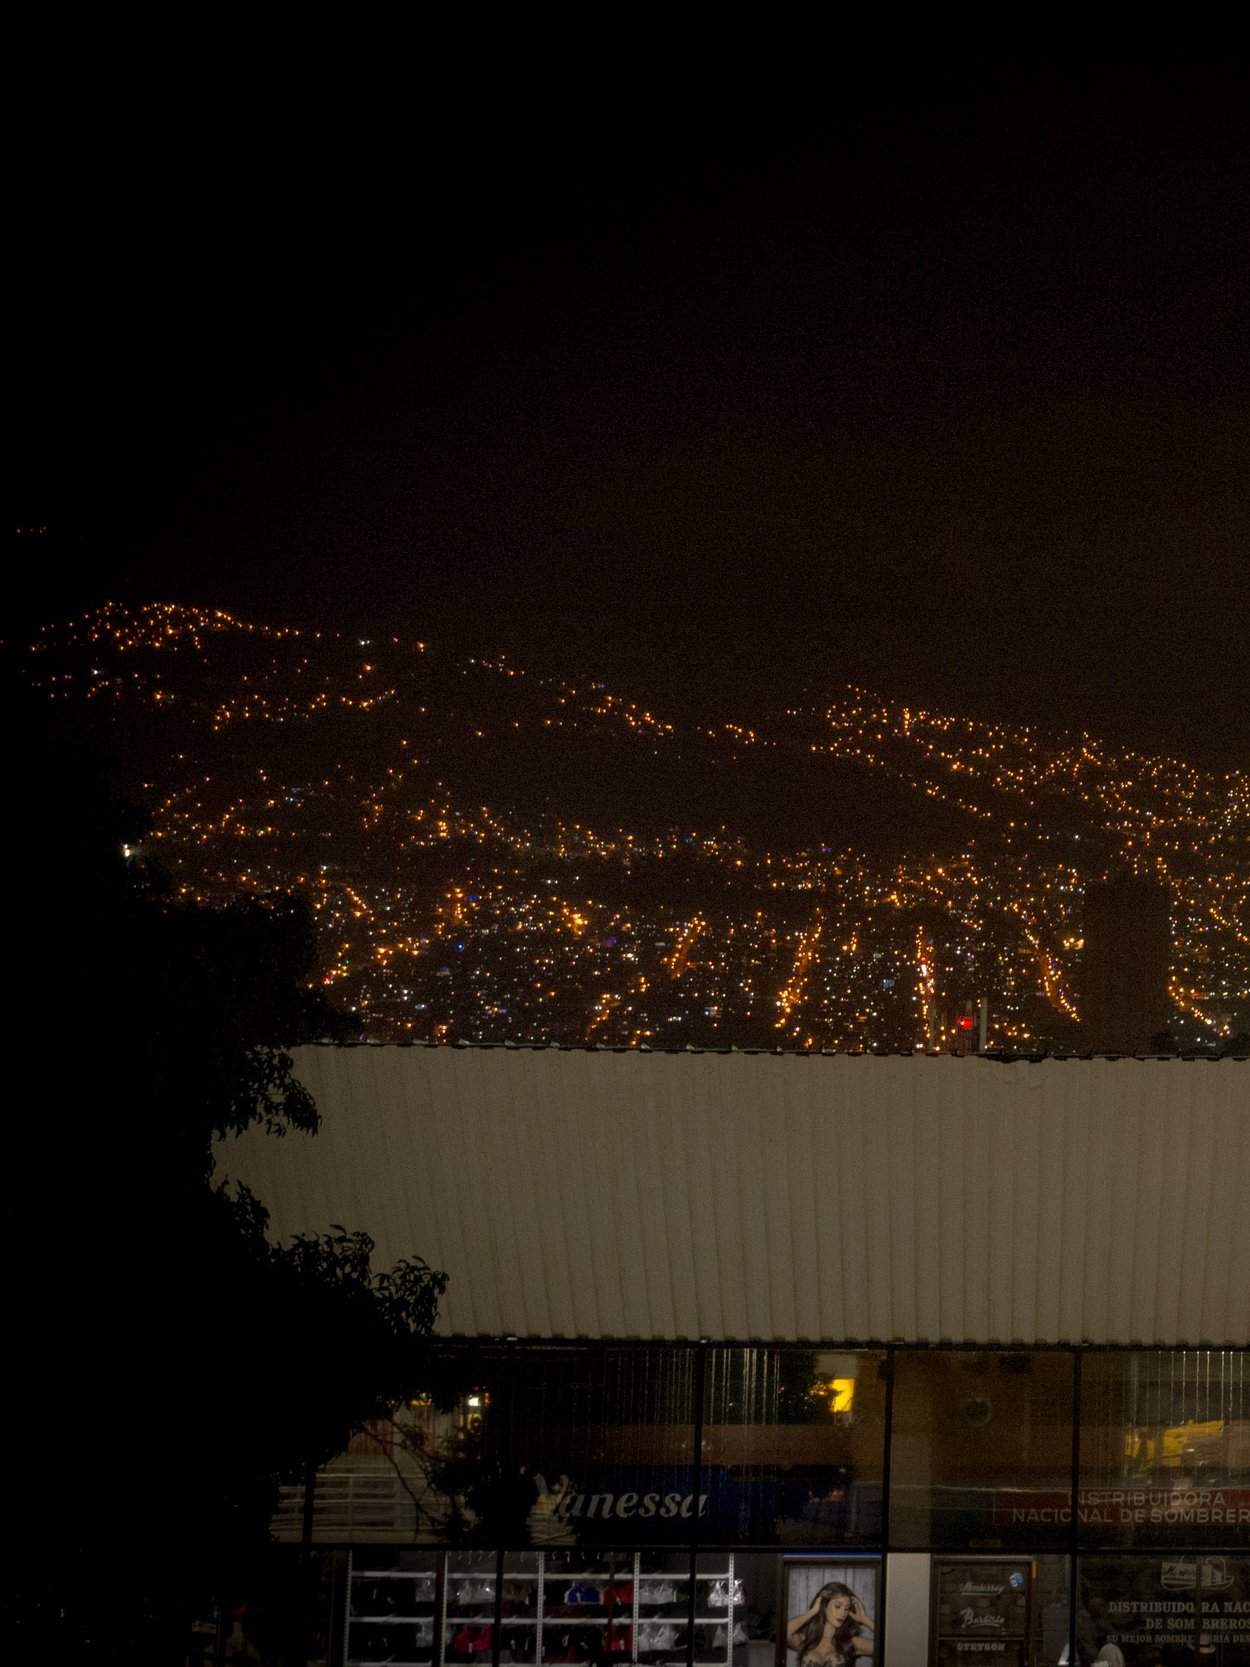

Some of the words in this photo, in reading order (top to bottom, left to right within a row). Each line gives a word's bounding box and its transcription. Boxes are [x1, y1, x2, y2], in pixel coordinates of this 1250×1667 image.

[532, 1473, 708, 1519] Vanessa
[1012, 1508, 1113, 1523] NACIONAL
[1120, 1508, 1145, 1523] DE
[1145, 1618, 1163, 1630] DE
[956, 1642, 1006, 1651] STETSON
